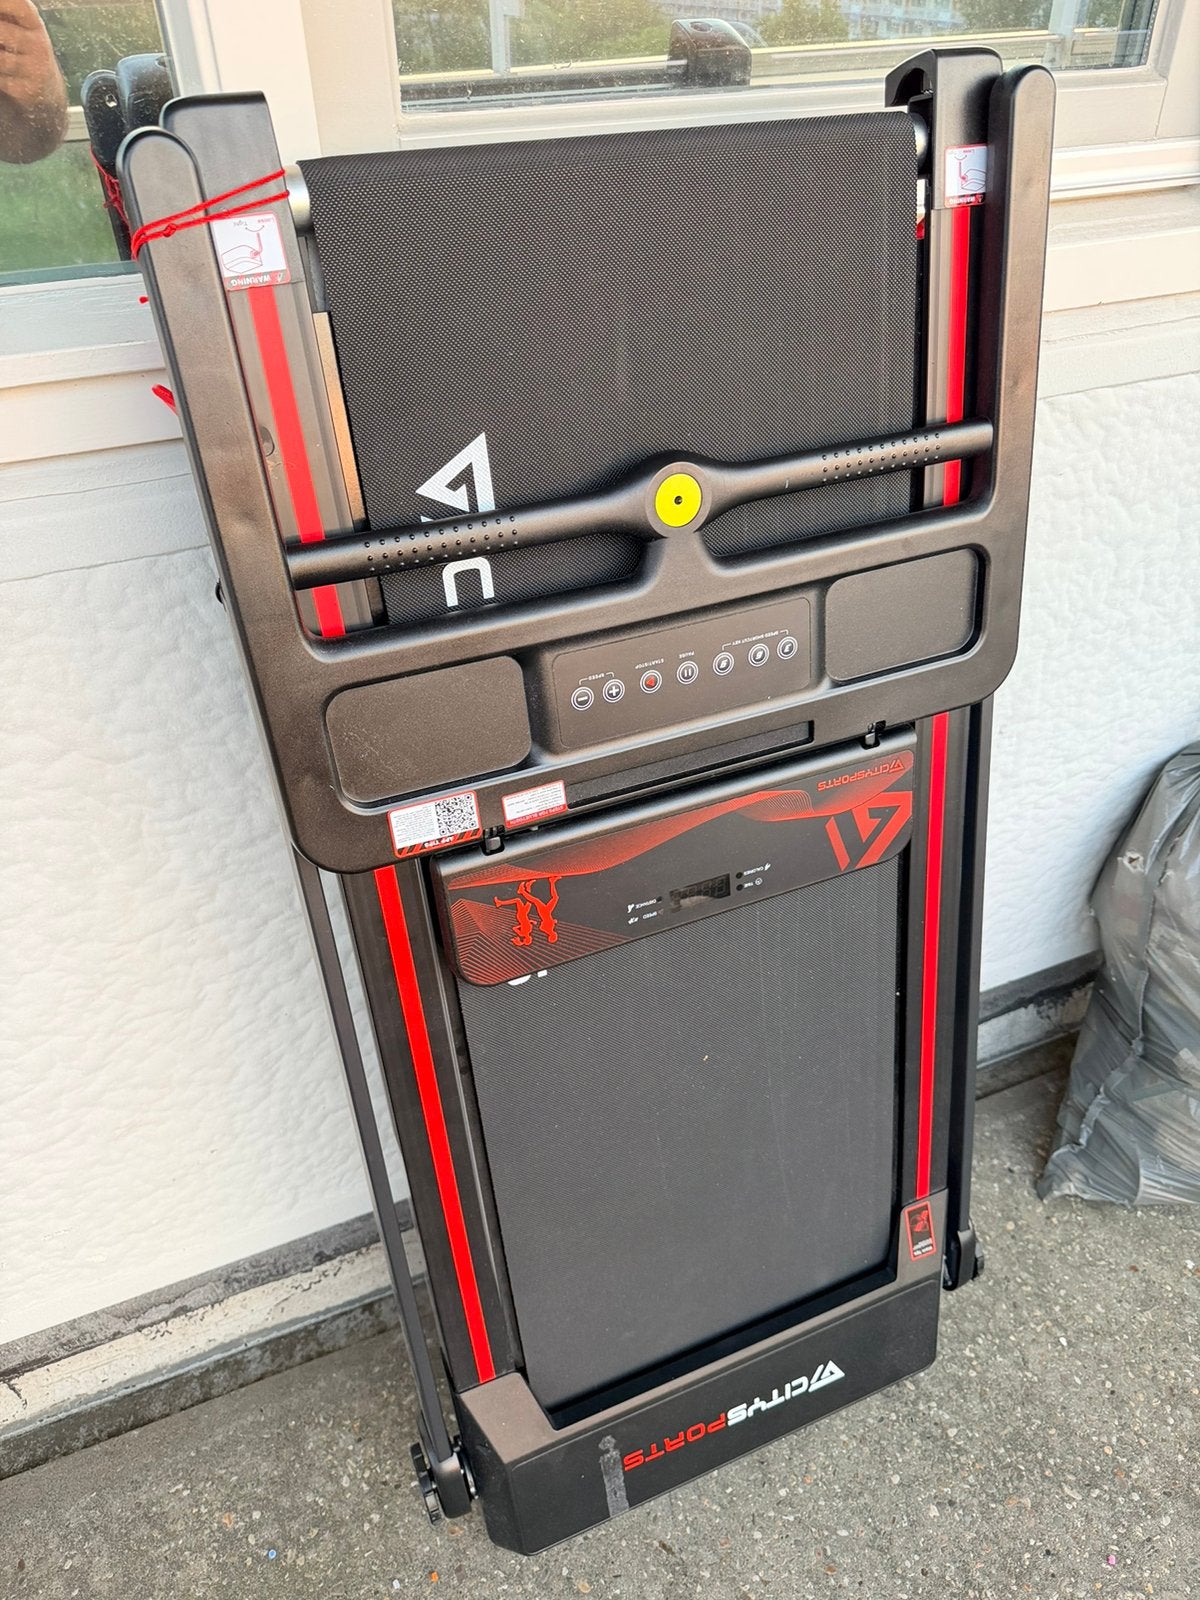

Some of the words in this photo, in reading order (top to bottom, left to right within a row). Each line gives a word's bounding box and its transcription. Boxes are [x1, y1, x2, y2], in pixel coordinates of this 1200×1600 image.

[949, 196, 976, 204] WARNING
[230, 274, 271, 287] WARNING
[741, 634, 764, 643] SHORTCUT
[764, 630, 779, 638] SPEED
[679, 650, 695, 659] PAUSE
[634, 658, 665, 670] START/STOP
[588, 672, 605, 681] SPEED
[817, 763, 890, 791] CITYSPORTS
[549, 805, 564, 813] STEPS
[509, 812, 538, 824] BLUETOOTH
[423, 839, 440, 848] TIPS
[440, 835, 454, 844] APP
[743, 865, 764, 876] CALORIES
[635, 898, 657, 909] DISTANCE
[642, 911, 658, 919] SPEED
[622, 1375, 810, 1472] CITYSPORTS
